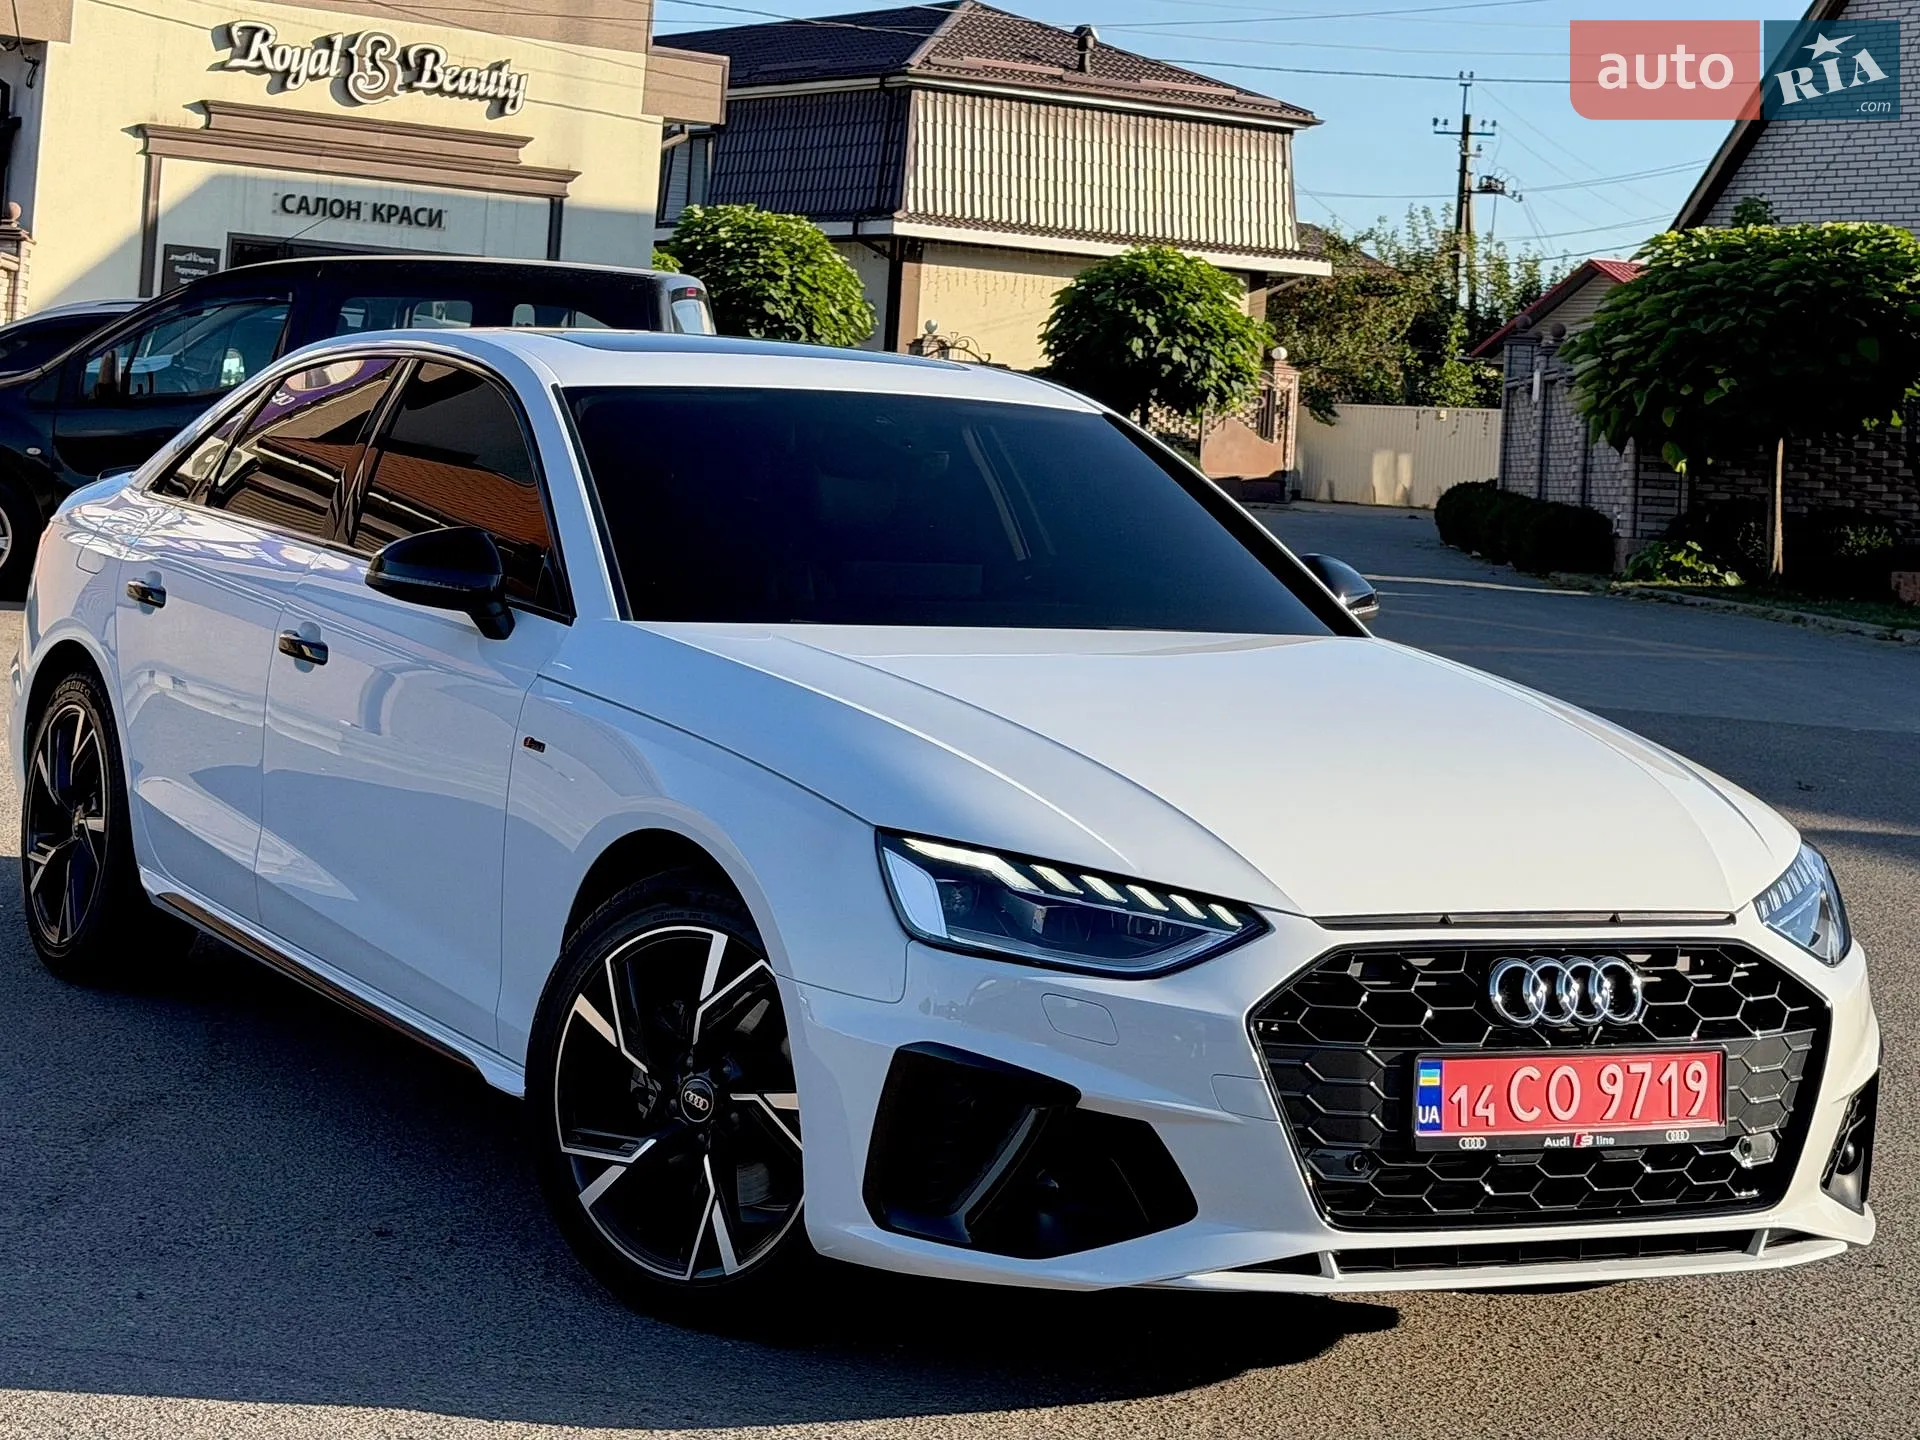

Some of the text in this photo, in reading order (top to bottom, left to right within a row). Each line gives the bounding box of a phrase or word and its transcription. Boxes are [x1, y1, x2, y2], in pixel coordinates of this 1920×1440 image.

[224, 20, 343, 91] Royal
[408, 43, 528, 116] Beauty
[280, 193, 443, 229] САЛОН КРАСИ
[1449, 1059, 1709, 1127] 14 CO 9719
[1418, 1105, 1440, 1124] UA
[1543, 1135, 1570, 1148] Audi
[1596, 1135, 1615, 1146] line
